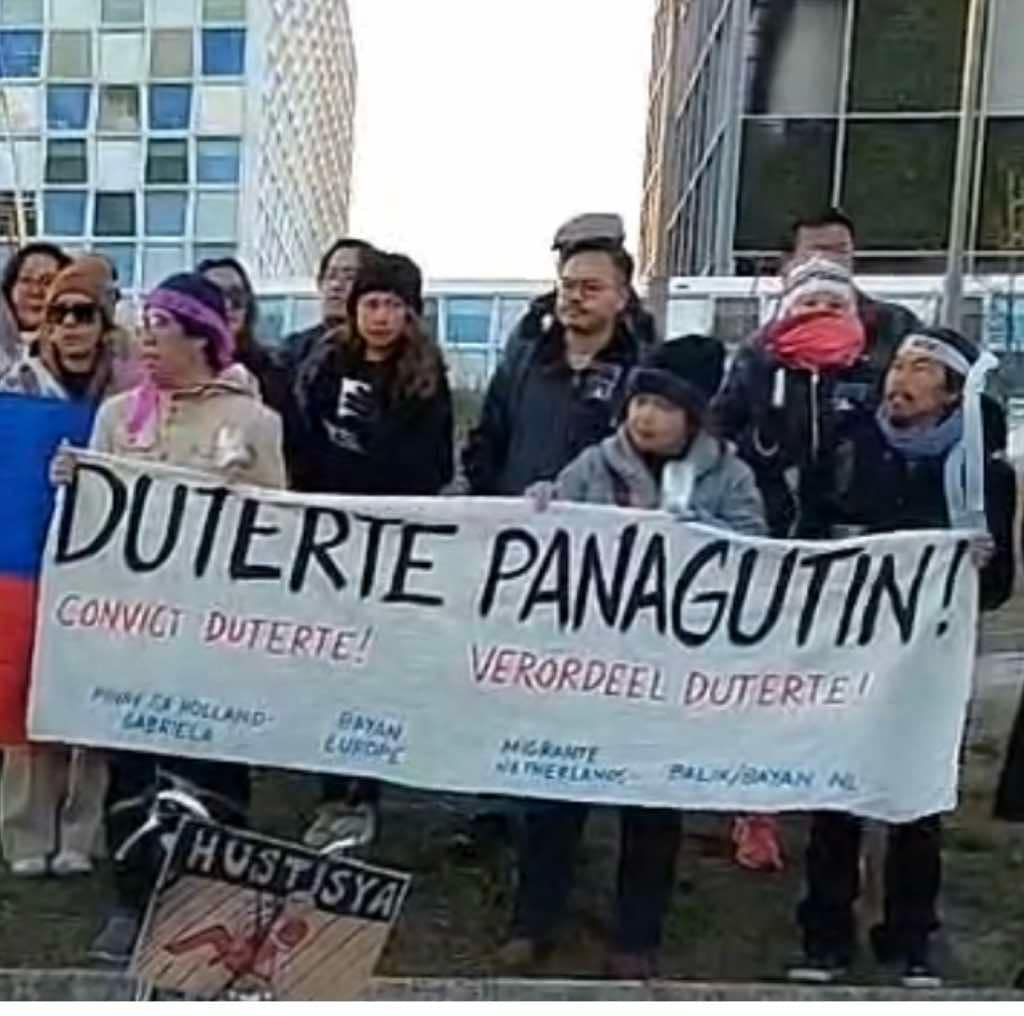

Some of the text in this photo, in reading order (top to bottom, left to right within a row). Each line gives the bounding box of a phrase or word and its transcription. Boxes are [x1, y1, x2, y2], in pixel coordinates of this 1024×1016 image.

[53, 463, 969, 647] DUTERTE PANAGUTIN!
[55, 594, 374, 664] CONVICT DUTERTE!
[471, 643, 874, 706] VERORDEEL DUTERTE!
[337, 710, 403, 740] BAYAN
[186, 827, 399, 917] HUSTISYA
